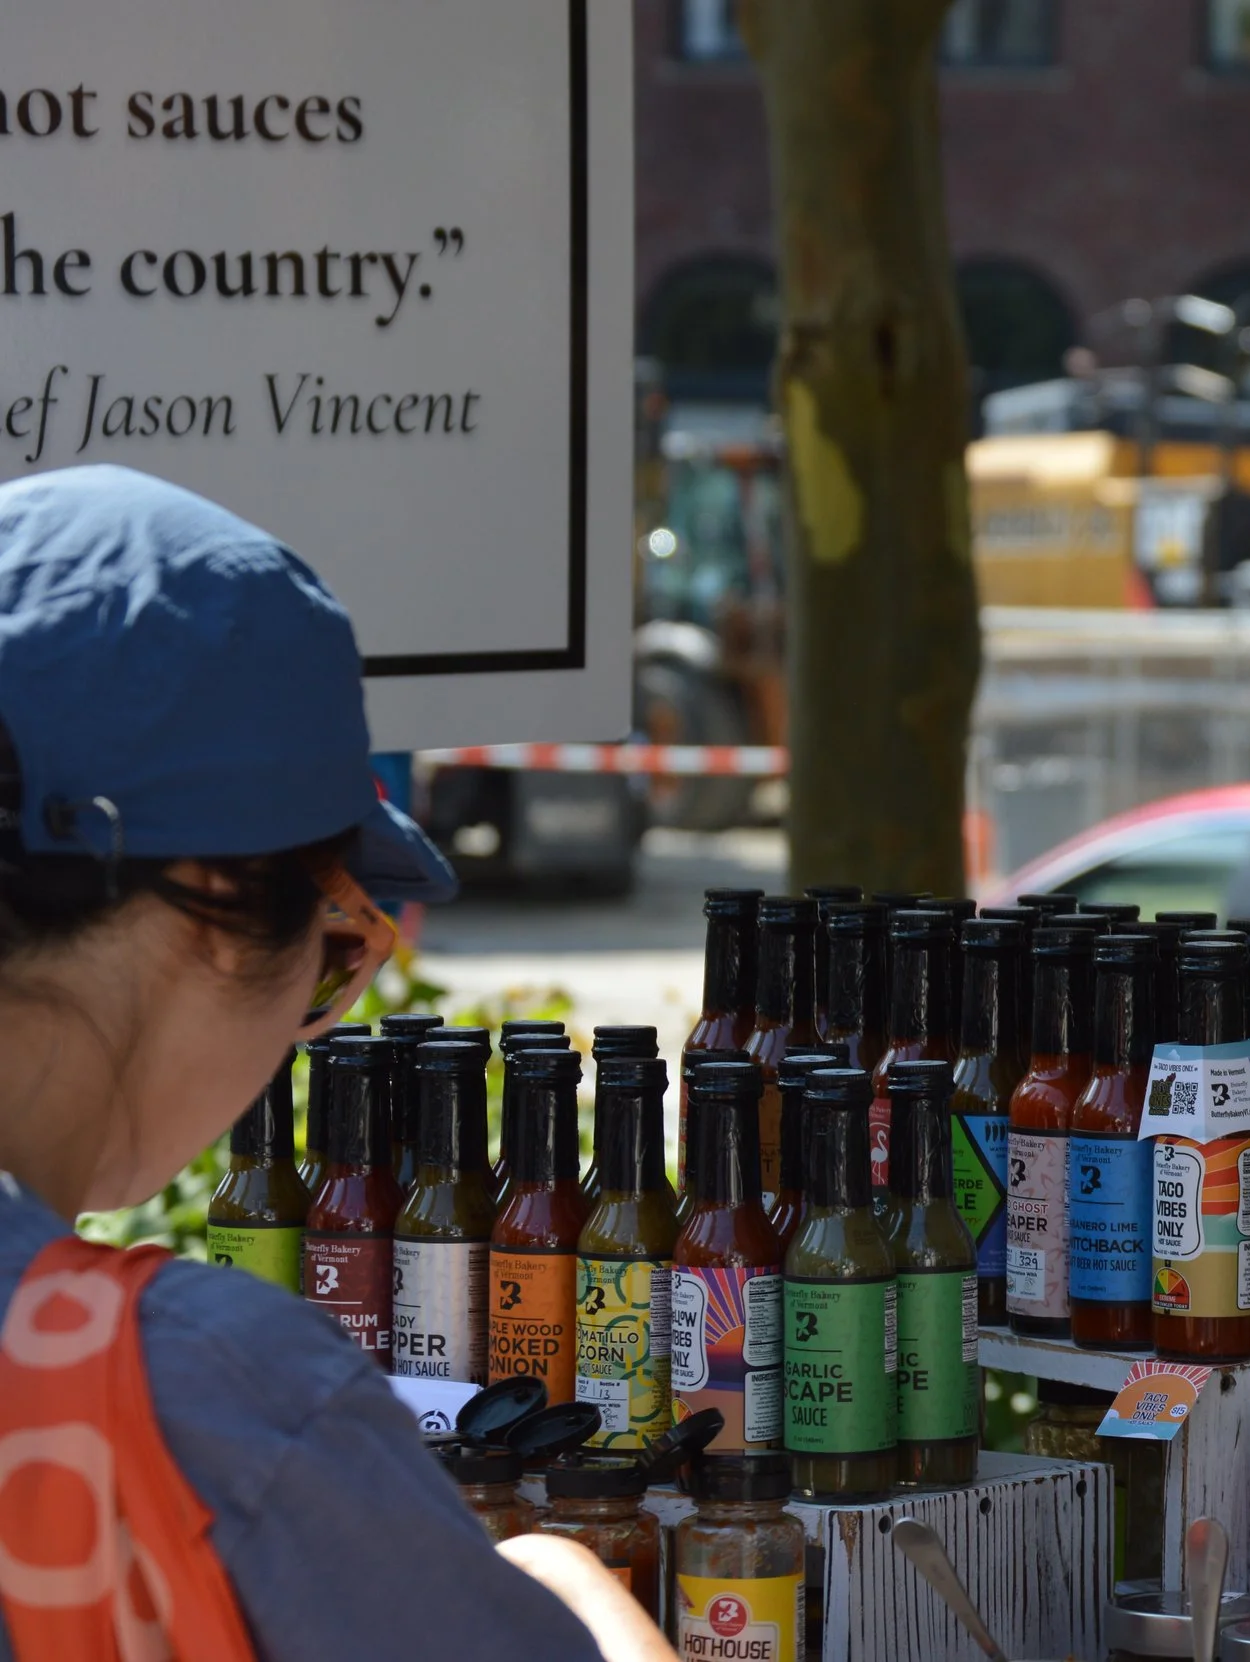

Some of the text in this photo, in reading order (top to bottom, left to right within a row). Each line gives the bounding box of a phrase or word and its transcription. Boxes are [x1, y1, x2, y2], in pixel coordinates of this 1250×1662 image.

[0, 83, 364, 142] ot sauces
[0, 365, 481, 463] ef Jason Vincent
[1169, 1064, 1181, 1072] VIBES
[1182, 1064, 1194, 1072] ONLY
[1021, 1139, 1045, 1151] Bakery
[1095, 1146, 1123, 1158] Bakery
[1172, 1164, 1190, 1173] Bakery
[1158, 1180, 1184, 1198] TACO
[1013, 1202, 1048, 1215] GHOST
[1156, 1200, 1187, 1218] VIBES
[1110, 1222, 1138, 1232] LIME
[1158, 1220, 1184, 1238] ONLY
[228, 1234, 255, 1246] Bakery
[1015, 1231, 1030, 1242] SAUCE
[1166, 1239, 1181, 1247] SAUCE
[331, 1245, 361, 1257] Bakery
[1071, 1236, 1144, 1253] ITCHBACK
[317, 1254, 348, 1263] Vermont
[1020, 1256, 1038, 1270] 329
[1093, 1260, 1107, 1270] HOT
[1110, 1260, 1137, 1272] SAUCE
[811, 1291, 840, 1303] Bakery
[340, 1314, 378, 1327] RUM
[393, 1315, 415, 1328] ADY
[491, 1322, 563, 1336] PLE WOOD
[578, 1332, 639, 1344] OMATILLO
[672, 1332, 692, 1348] IBES
[490, 1338, 559, 1356] MOKED
[579, 1344, 624, 1362] CORN
[672, 1349, 690, 1368] NLY
[416, 1361, 450, 1377] SAUCE
[592, 1364, 612, 1375] SAUCE
[786, 1361, 842, 1379] GARLIC
[1144, 1393, 1168, 1403] TACO
[1136, 1402, 1185, 1415] VIBES $15
[792, 1406, 827, 1426] SAUCE
[1133, 1411, 1158, 1421] ONLY
